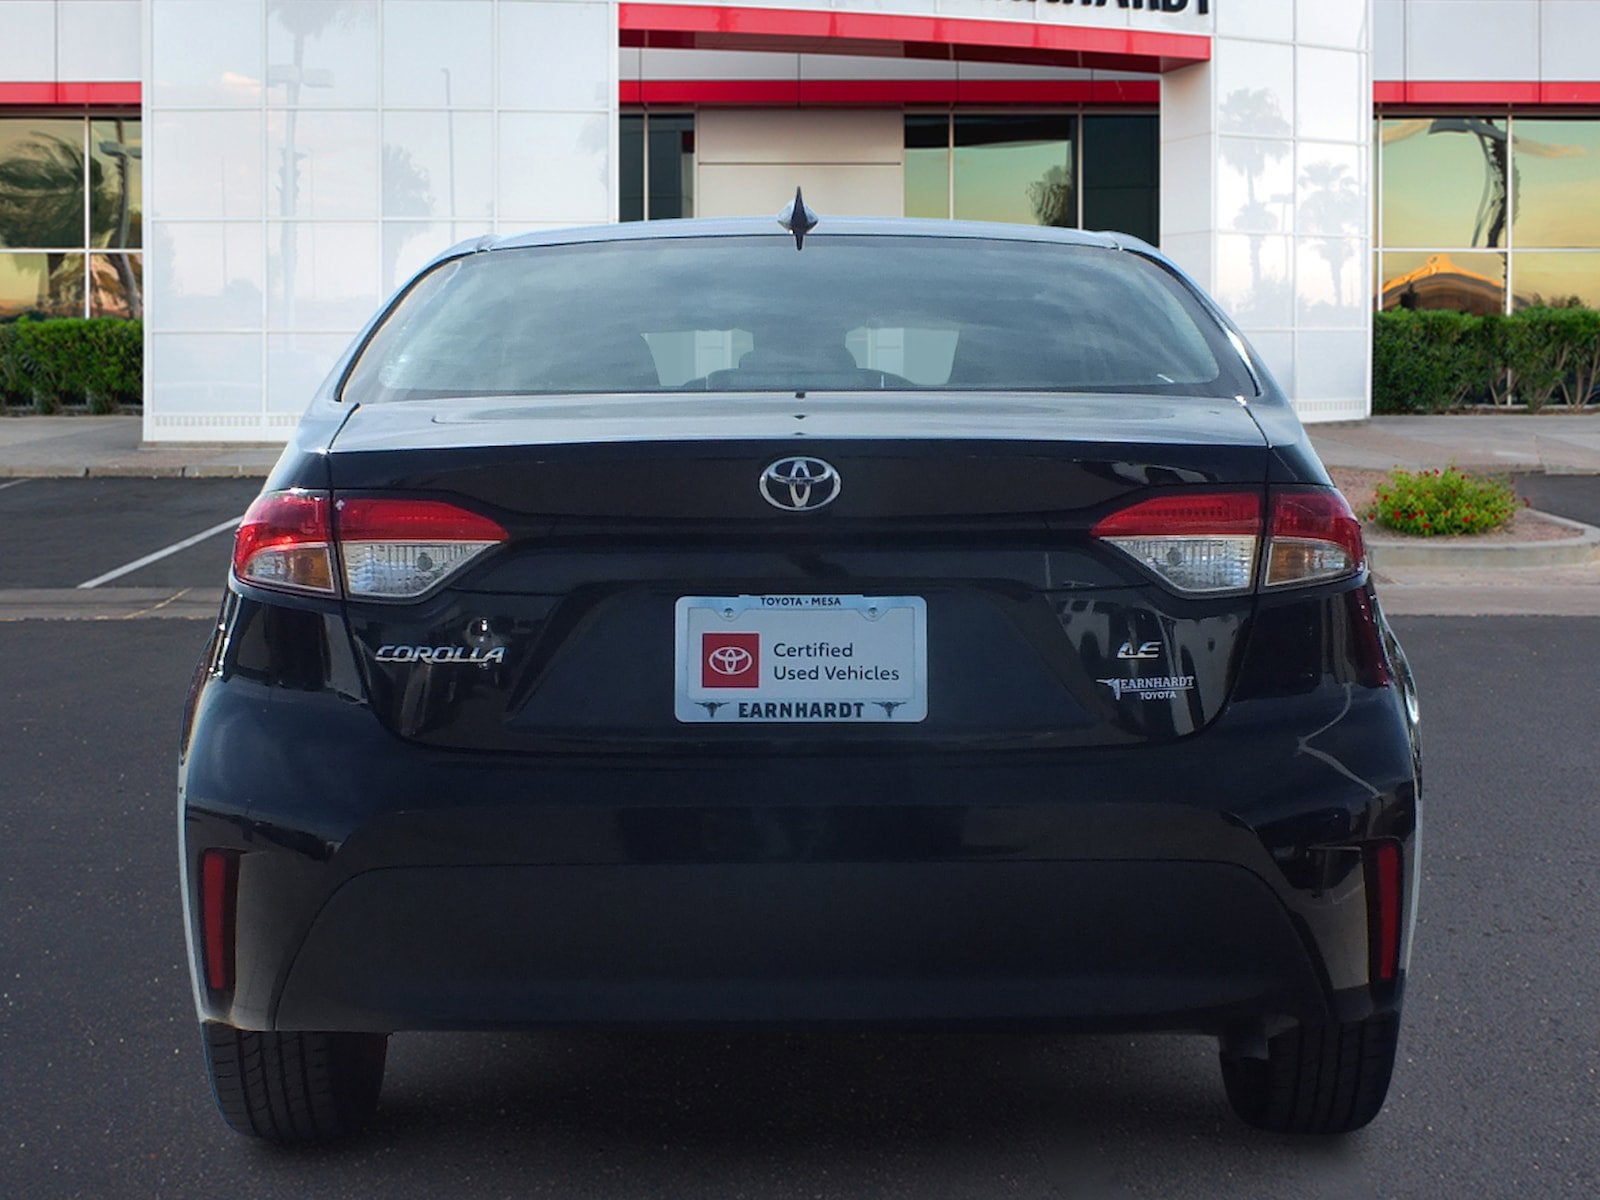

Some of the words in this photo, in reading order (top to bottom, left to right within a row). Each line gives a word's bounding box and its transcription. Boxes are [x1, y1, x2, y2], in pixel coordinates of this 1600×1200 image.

[761, 597, 802, 606] TOYOTA
[811, 597, 841, 606] MESA
[375, 645, 506, 663] COROLLA
[773, 642, 853, 658] Certified
[773, 665, 819, 681] Used
[825, 665, 900, 681] Vehicles
[1120, 676, 1194, 688] EARNHARDT
[1140, 691, 1177, 700] TOYOTA
[738, 702, 865, 718] EARNHARDT
